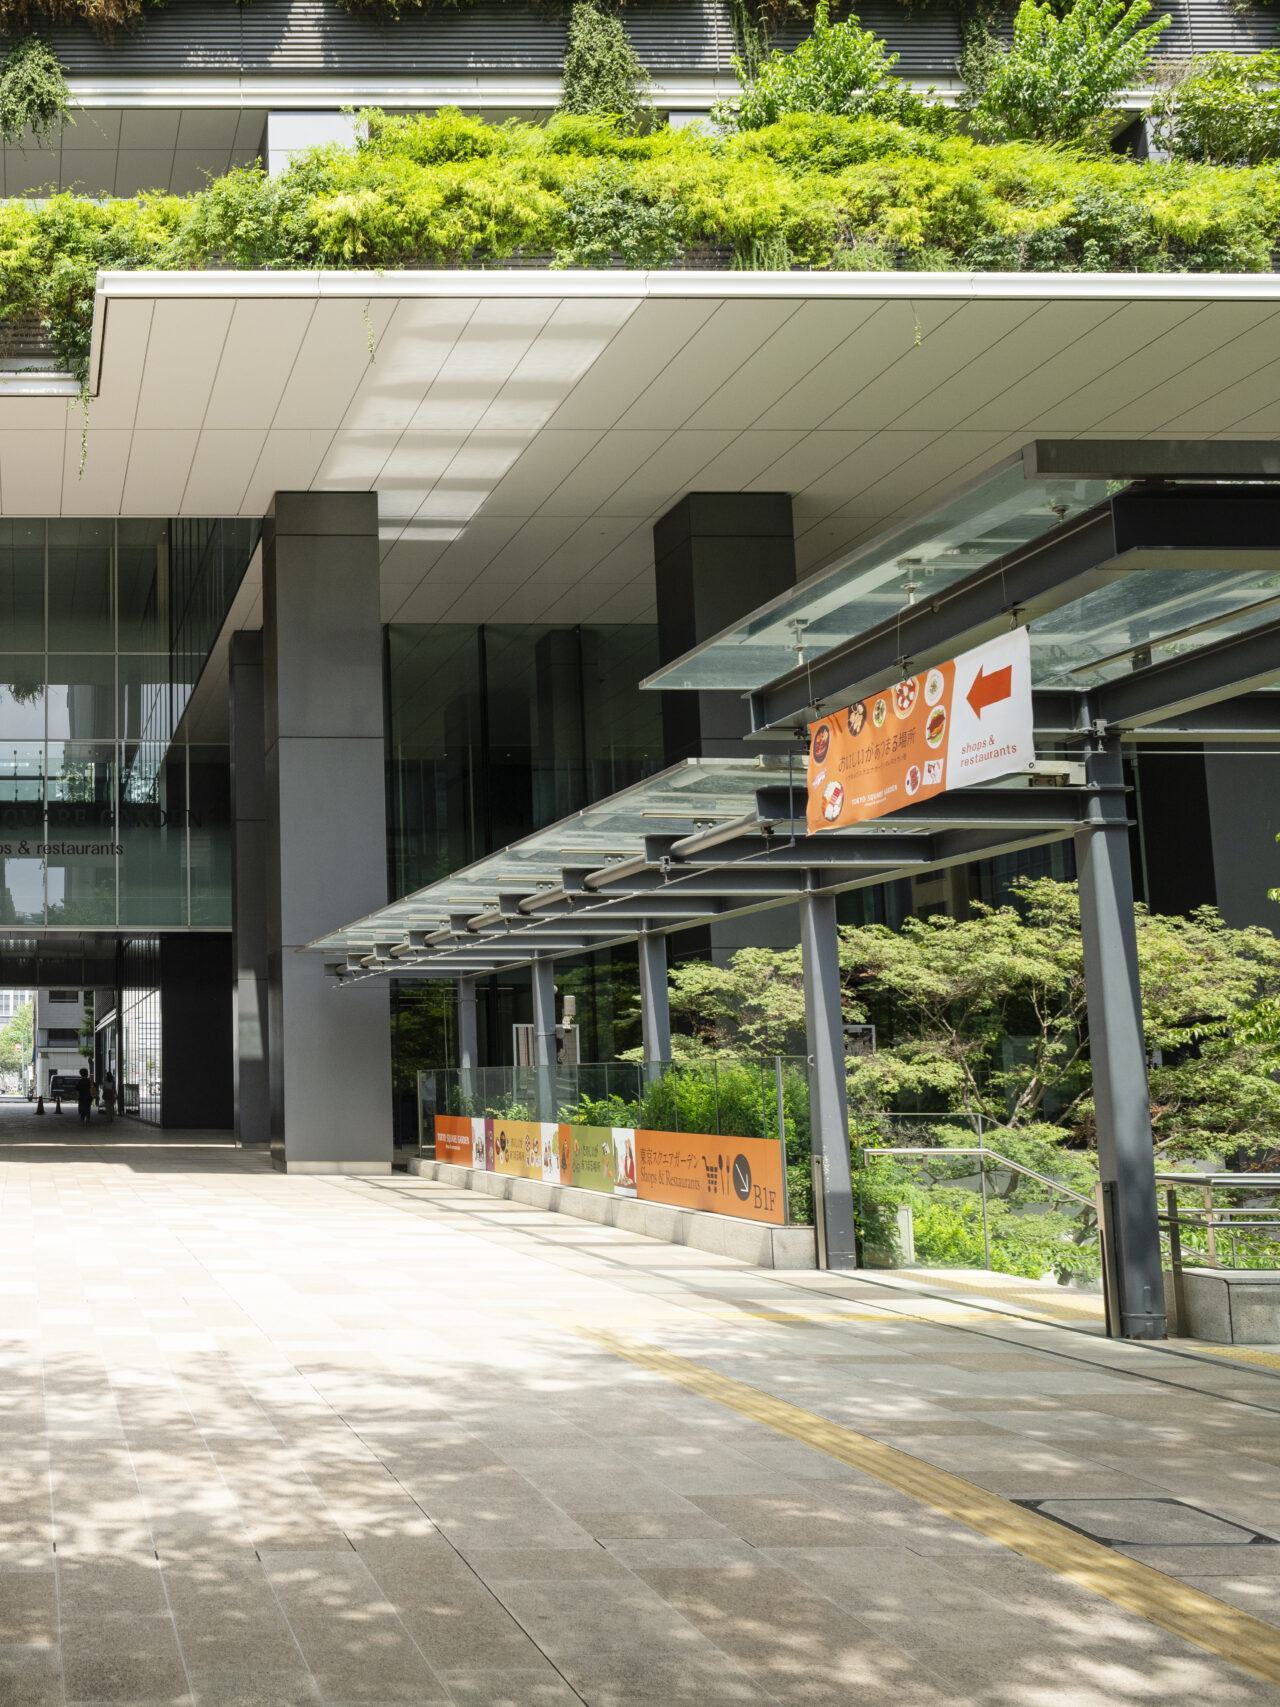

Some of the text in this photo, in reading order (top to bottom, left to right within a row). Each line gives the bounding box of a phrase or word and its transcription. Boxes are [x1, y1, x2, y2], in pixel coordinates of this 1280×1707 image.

[961, 734, 995, 755] shops &
[960, 744, 1017, 768] restaurants
[17, 840, 31, 855] &
[36, 841, 124, 855] restaurants
[640, 1148, 699, 1169] 東京スクエアガーデン
[640, 1166, 701, 1191] Shops & Restaurants
[753, 1184, 777, 1212] B1F
